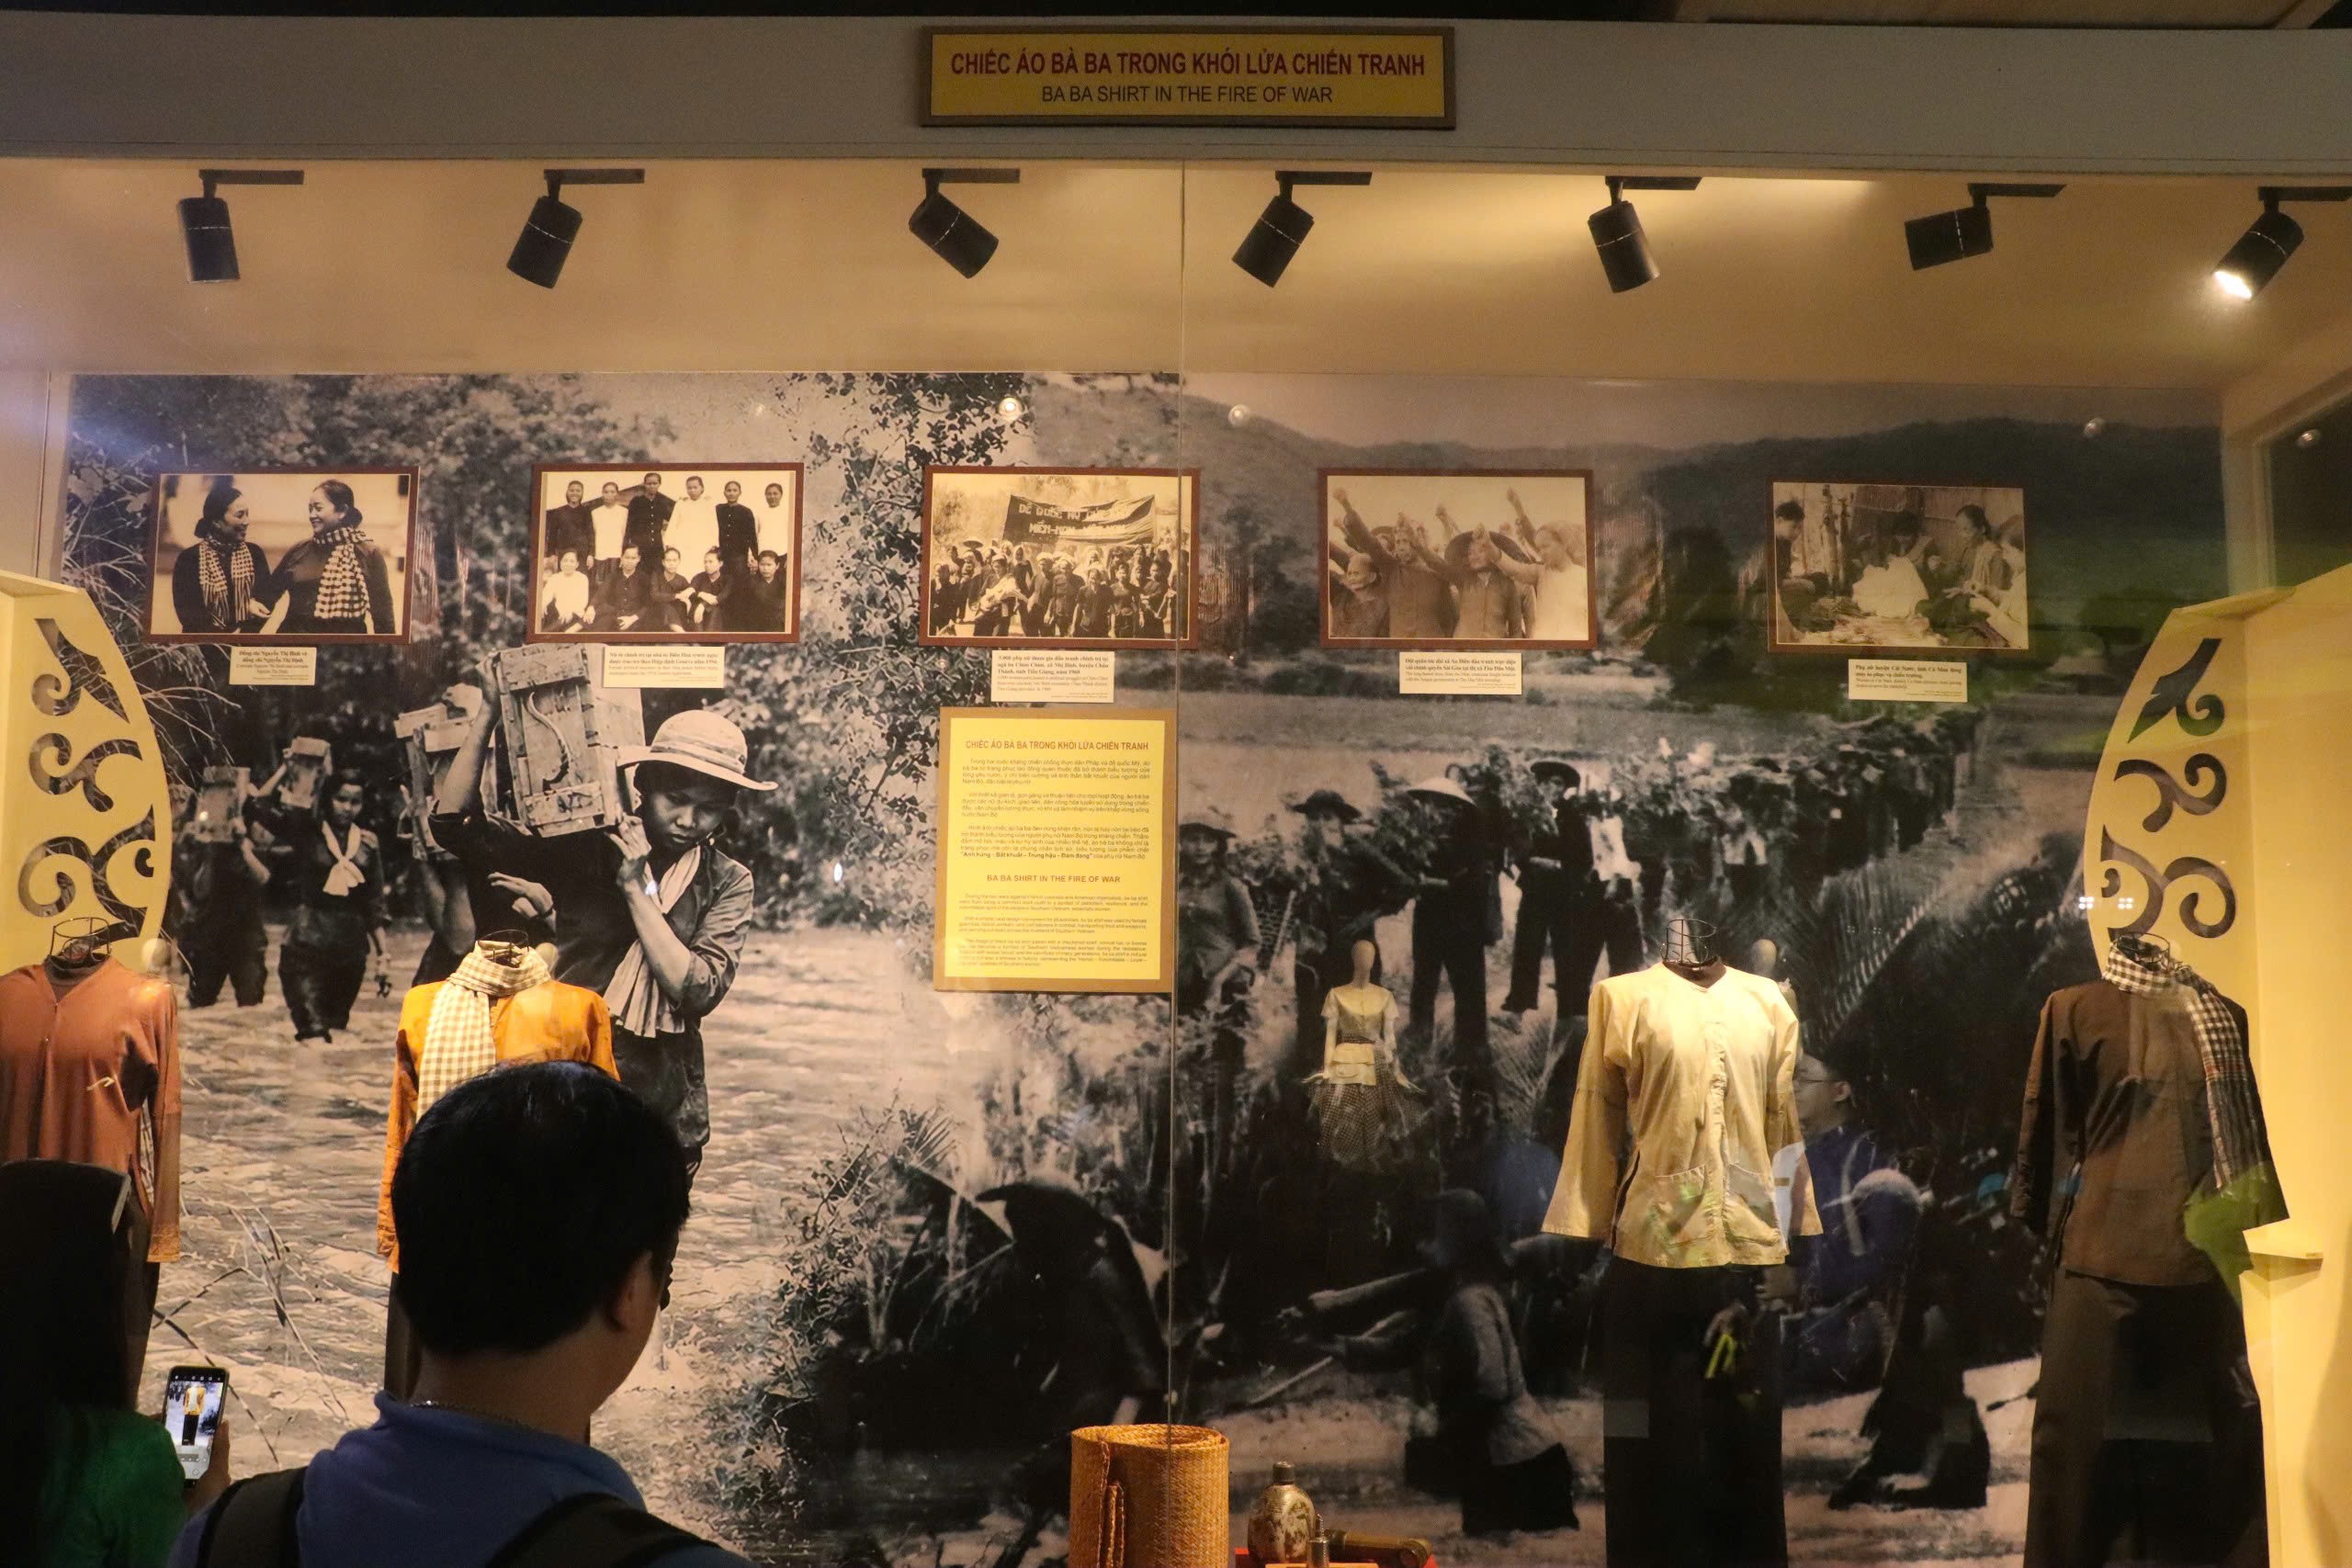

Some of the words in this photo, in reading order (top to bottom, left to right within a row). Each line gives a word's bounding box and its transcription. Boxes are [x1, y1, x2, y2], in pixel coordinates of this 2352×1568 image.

[952, 49, 1011, 74] CHIẾC
[1016, 48, 1045, 74] ÁO
[1051, 49, 1079, 74] BÀ
[1084, 54, 1110, 74] BA
[1117, 54, 1186, 74] TRONG
[1193, 49, 1240, 75] KHÓI
[1247, 49, 1287, 75] LỬA
[1293, 50, 1351, 75] CHIẾN
[1358, 55, 1424, 75] TRANH
[1042, 86, 1065, 101] BA
[1069, 86, 1092, 101] BA
[1097, 86, 1151, 102] SHIRT
[1155, 86, 1171, 102] IN
[1176, 87, 1211, 102] THE
[1217, 87, 1257, 102] FIRE
[1262, 87, 1286, 103] OF
[1292, 87, 1333, 103] WAR
